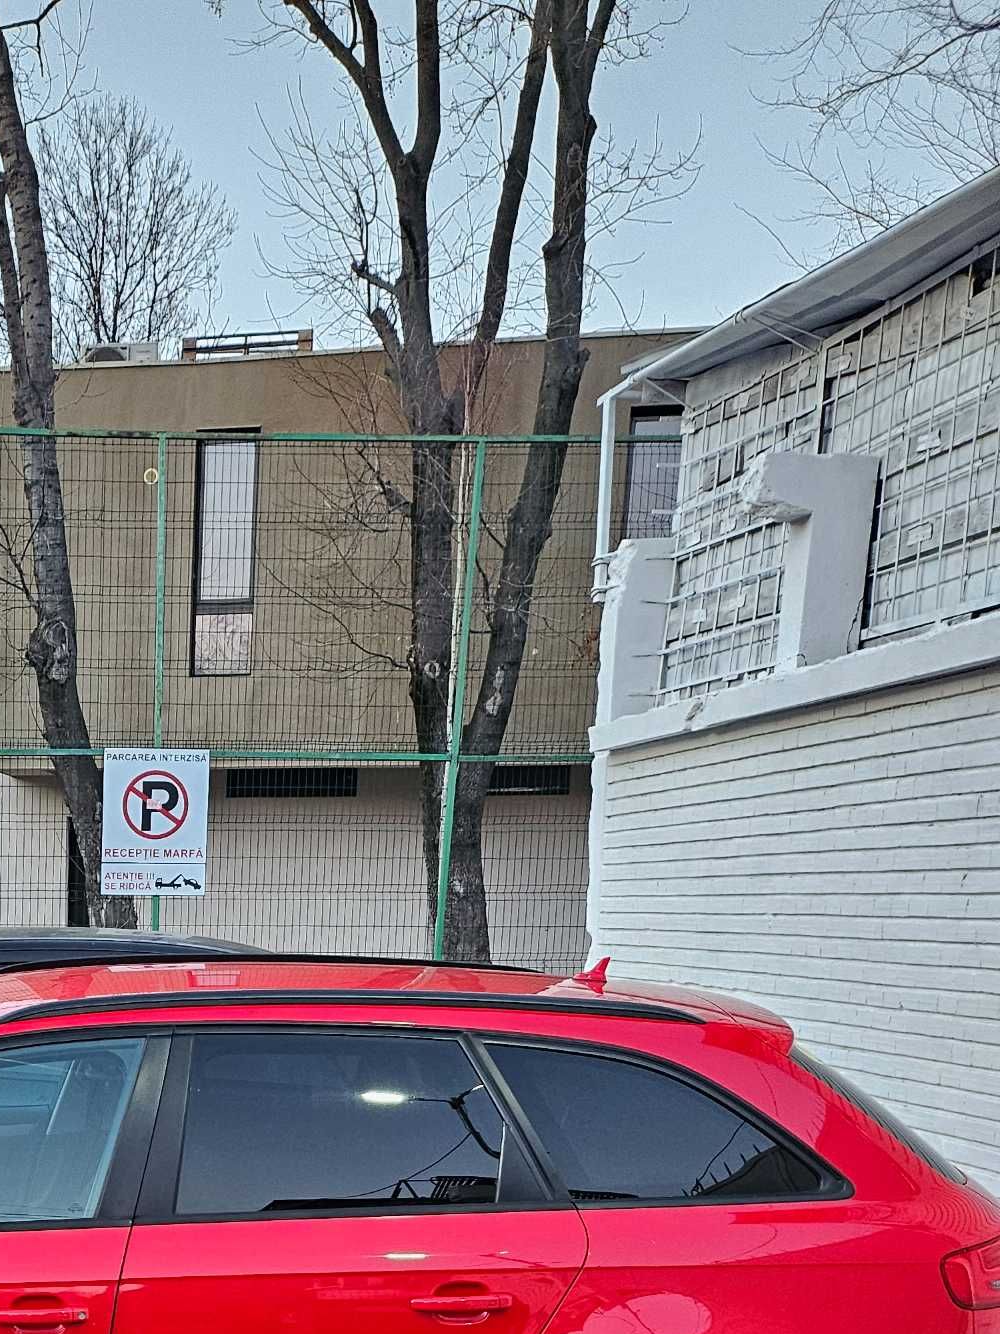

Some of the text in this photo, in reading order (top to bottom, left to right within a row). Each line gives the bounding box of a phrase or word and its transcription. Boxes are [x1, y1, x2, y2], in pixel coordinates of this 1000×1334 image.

[106, 753, 157, 761] PARCAREA
[141, 781, 179, 831] P
[163, 848, 203, 858] MARFĂ
